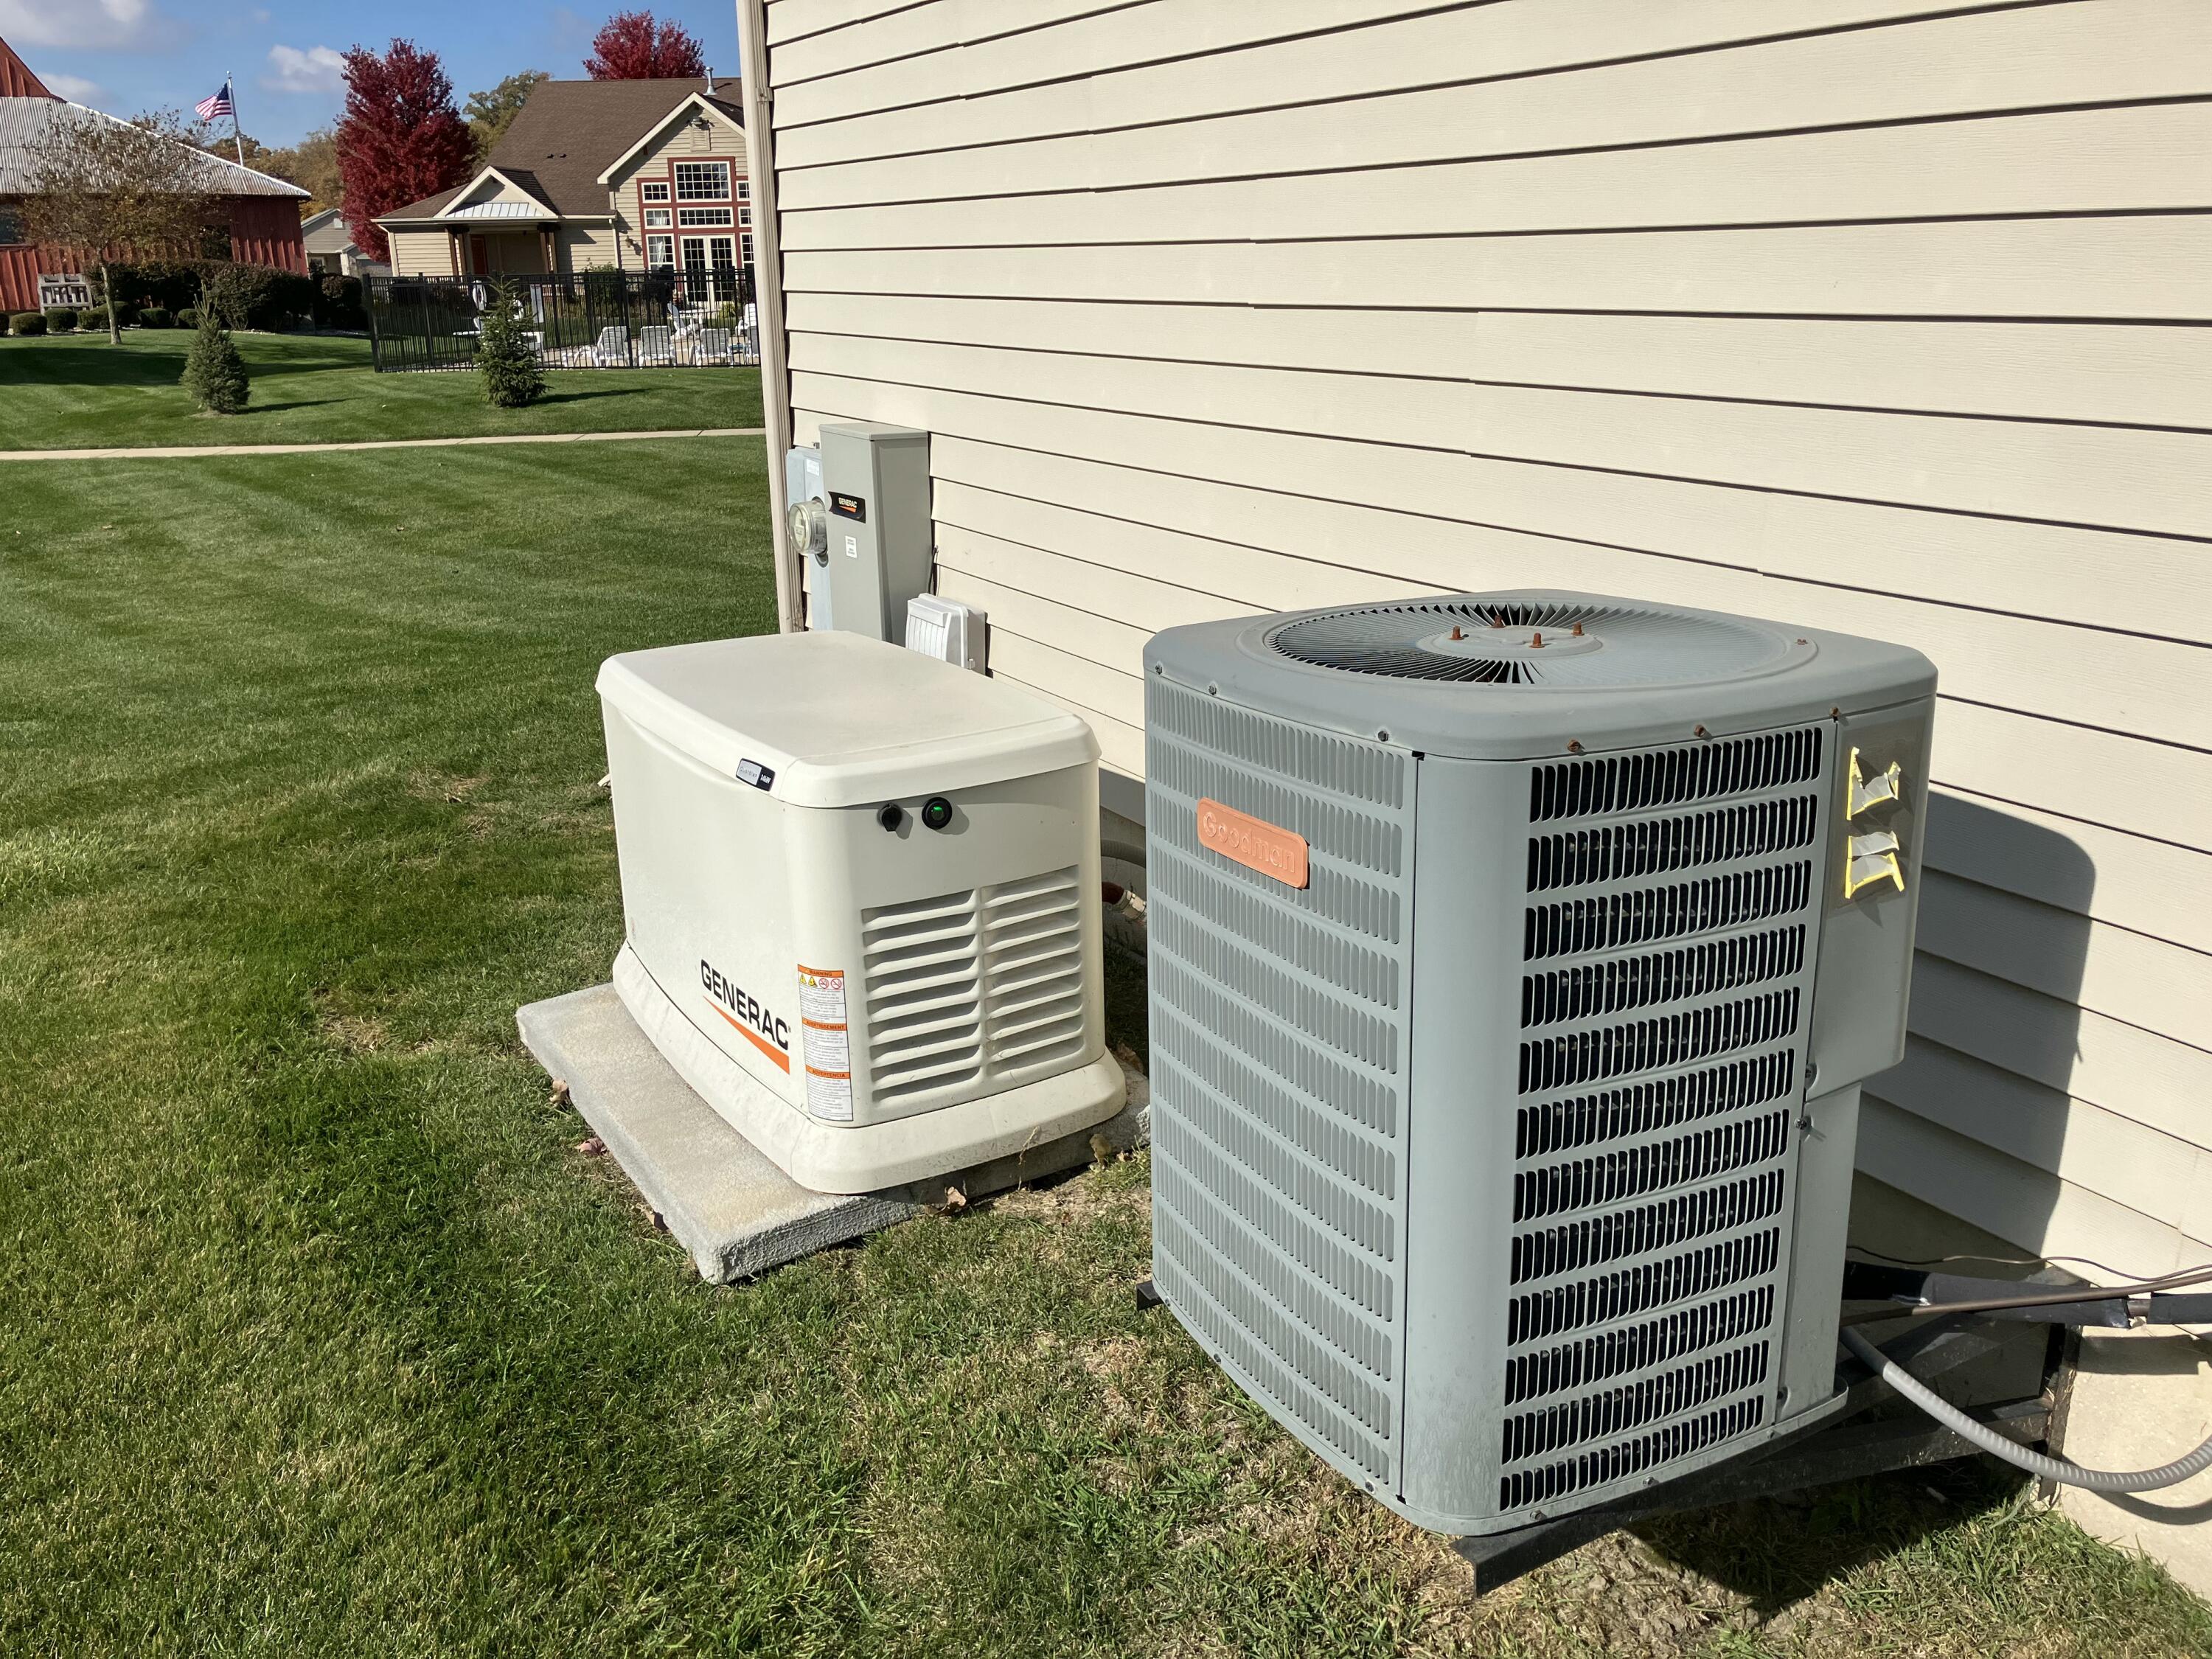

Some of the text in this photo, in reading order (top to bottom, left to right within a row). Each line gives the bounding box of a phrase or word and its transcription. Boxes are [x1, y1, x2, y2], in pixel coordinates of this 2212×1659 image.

[838, 497, 858, 509] GENERAC
[1203, 811, 1295, 874] Goodman
[808, 970, 832, 978] WARNING
[701, 959, 789, 1051] GENERAC
